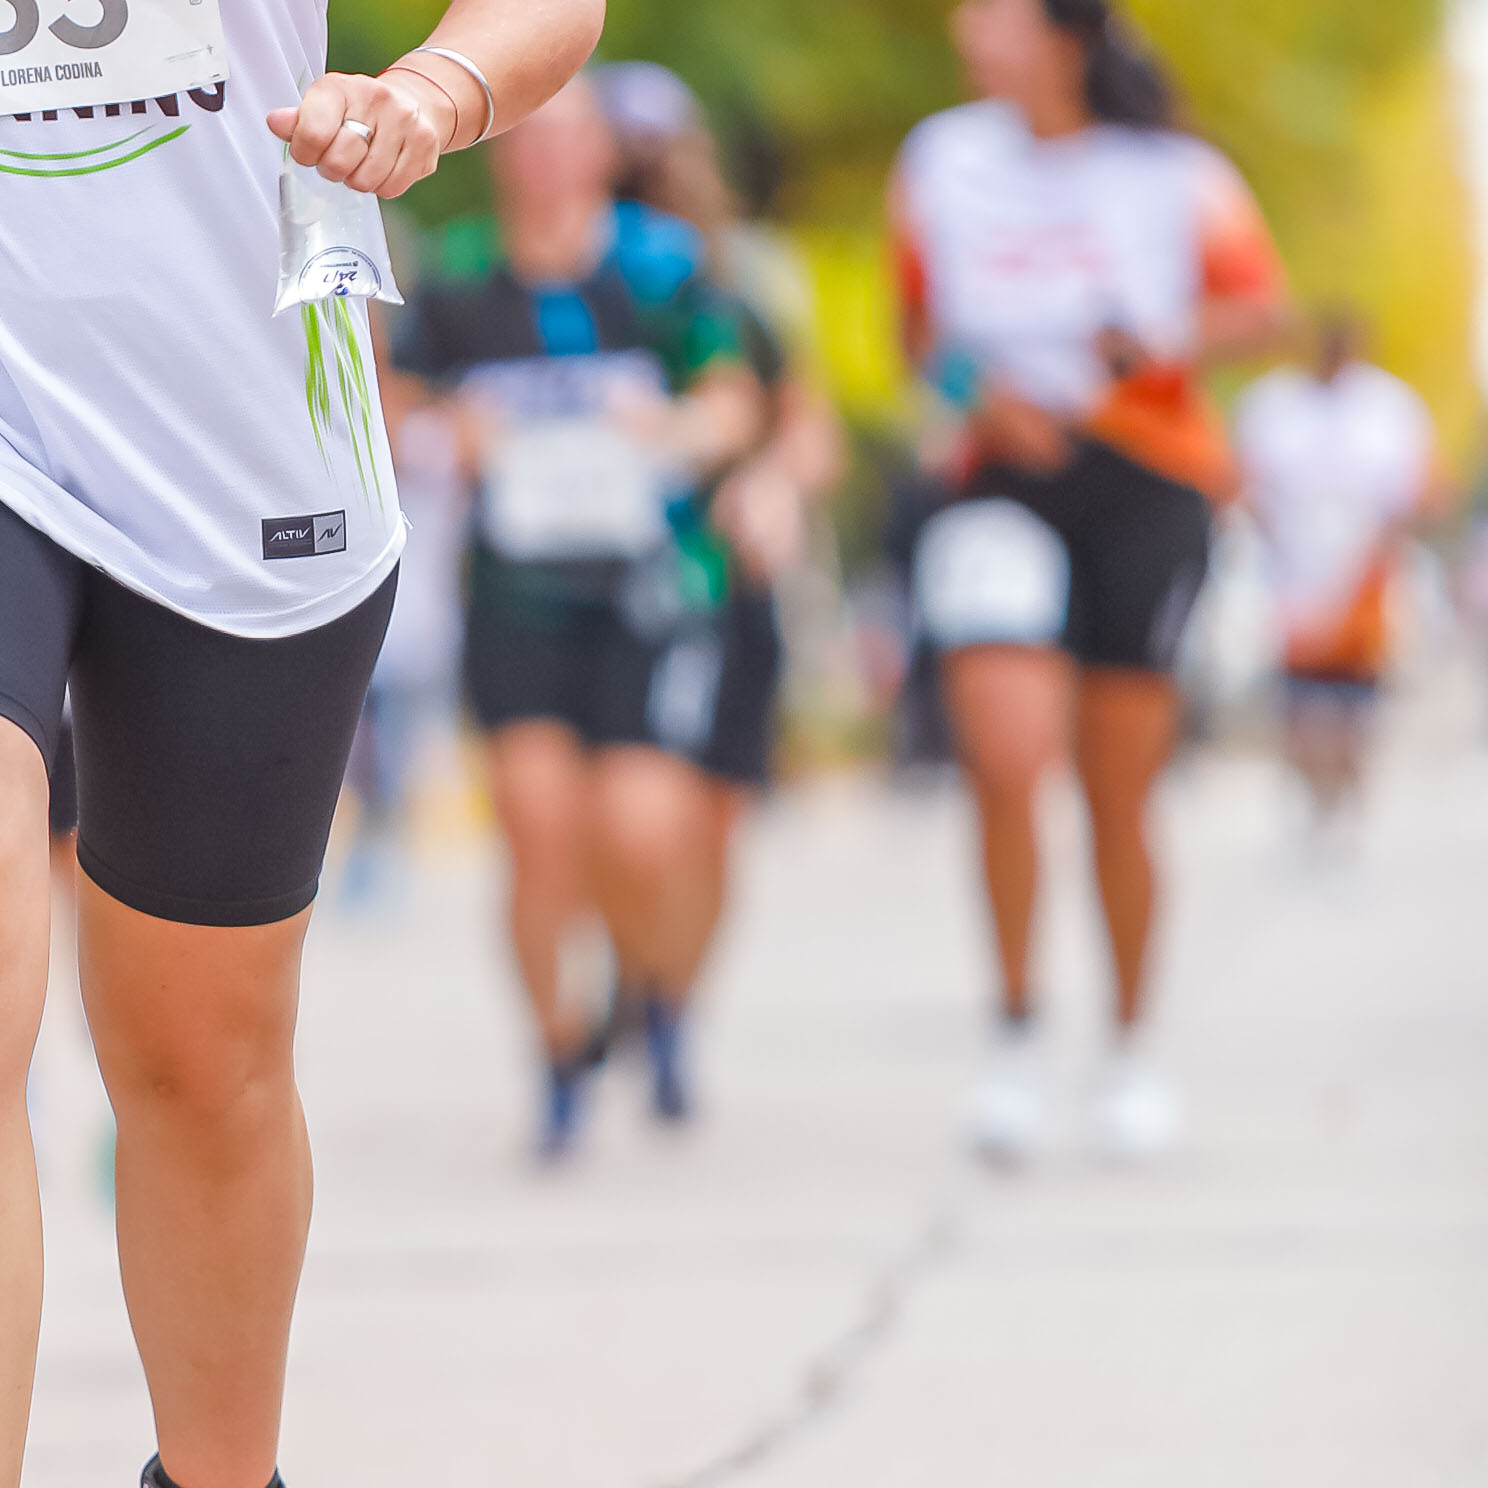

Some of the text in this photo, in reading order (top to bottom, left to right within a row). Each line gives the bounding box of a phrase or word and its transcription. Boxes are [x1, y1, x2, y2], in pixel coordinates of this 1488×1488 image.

[0, 61, 103, 87] LORENA CODINA
[269, 526, 311, 542] ALTIV
